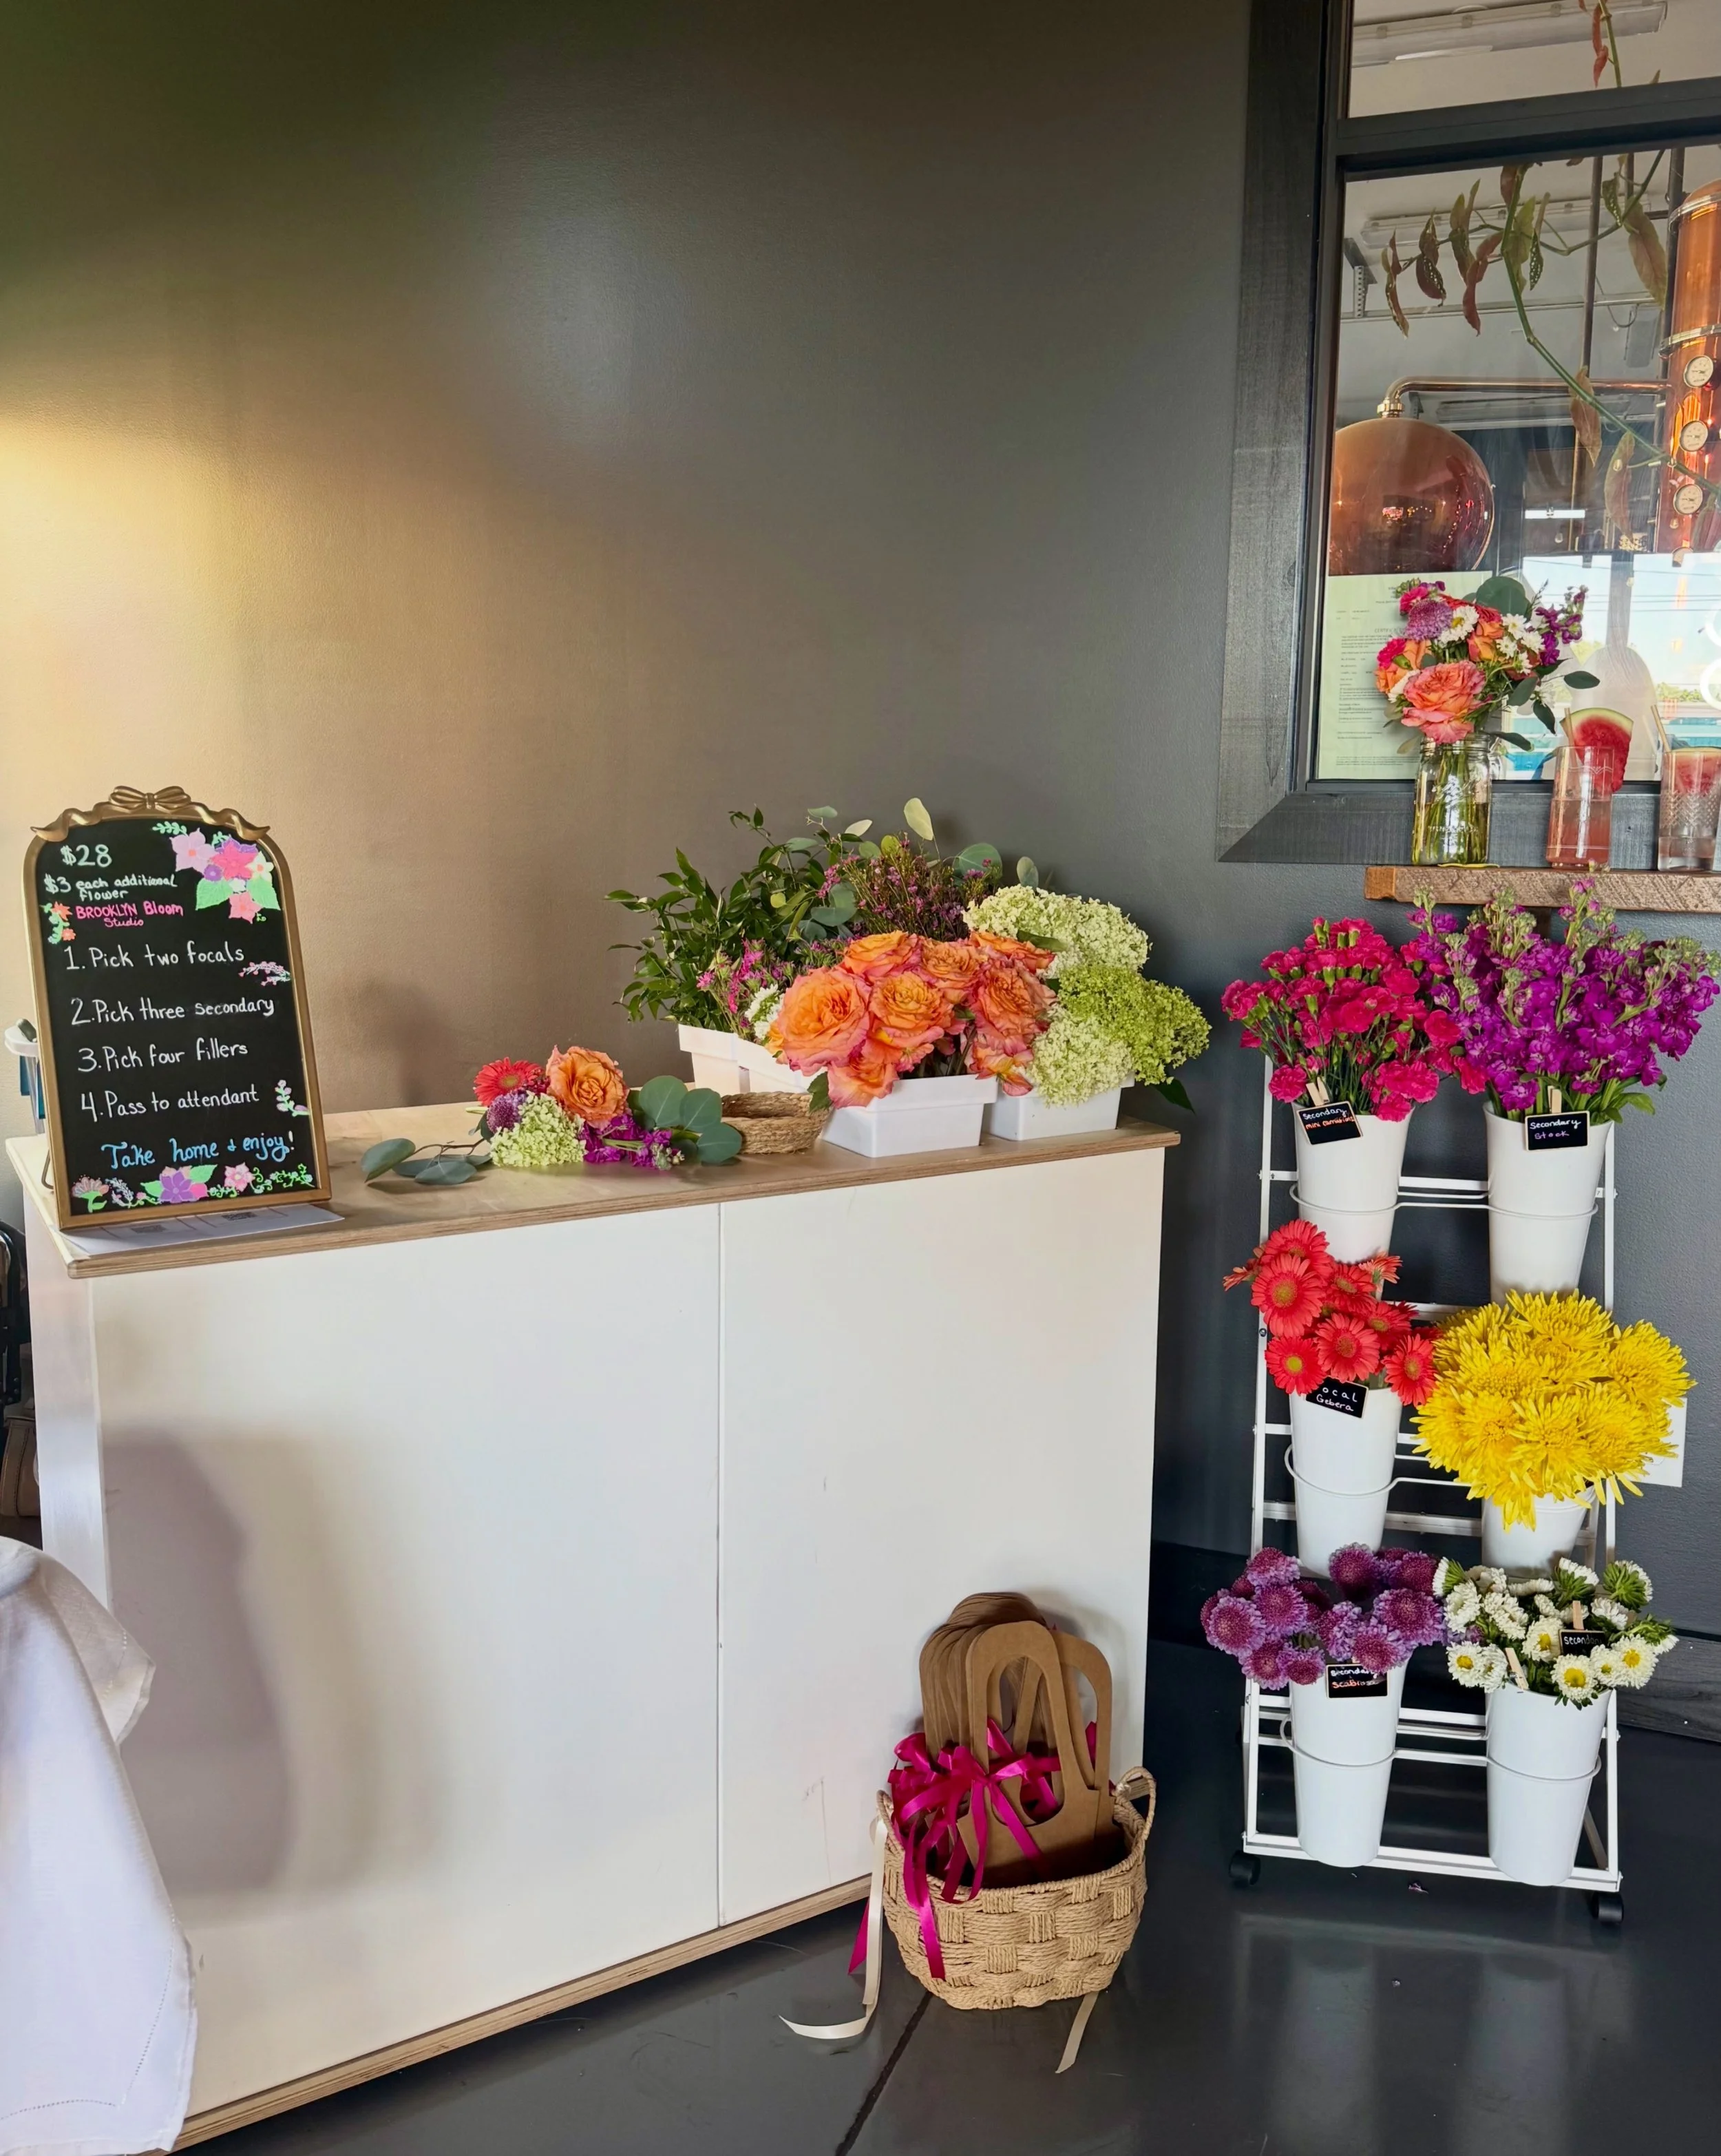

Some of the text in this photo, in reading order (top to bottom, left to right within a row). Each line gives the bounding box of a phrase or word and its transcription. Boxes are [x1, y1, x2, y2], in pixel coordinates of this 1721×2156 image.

[60, 844, 112, 868] $28
[43, 873, 72, 894] $3
[75, 877, 109, 890] each
[75, 900, 184, 920] BROOKLYN Bloom
[103, 917, 144, 928] Studio
[145, 943, 179, 967] two
[187, 940, 244, 964] focals
[139, 996, 186, 1021] three
[194, 996, 275, 1017] secondary
[149, 1043, 185, 1067] four
[196, 1037, 249, 1061] fillers
[151, 1091, 170, 1112] to
[177, 1083, 260, 1109] attendant
[101, 1141, 156, 1170] Take
[169, 1138, 220, 1162] home
[242, 1131, 295, 1162] enjoy!
[1316, 1394, 1354, 1412] Gebera
[1322, 1387, 1358, 1403] ocal
